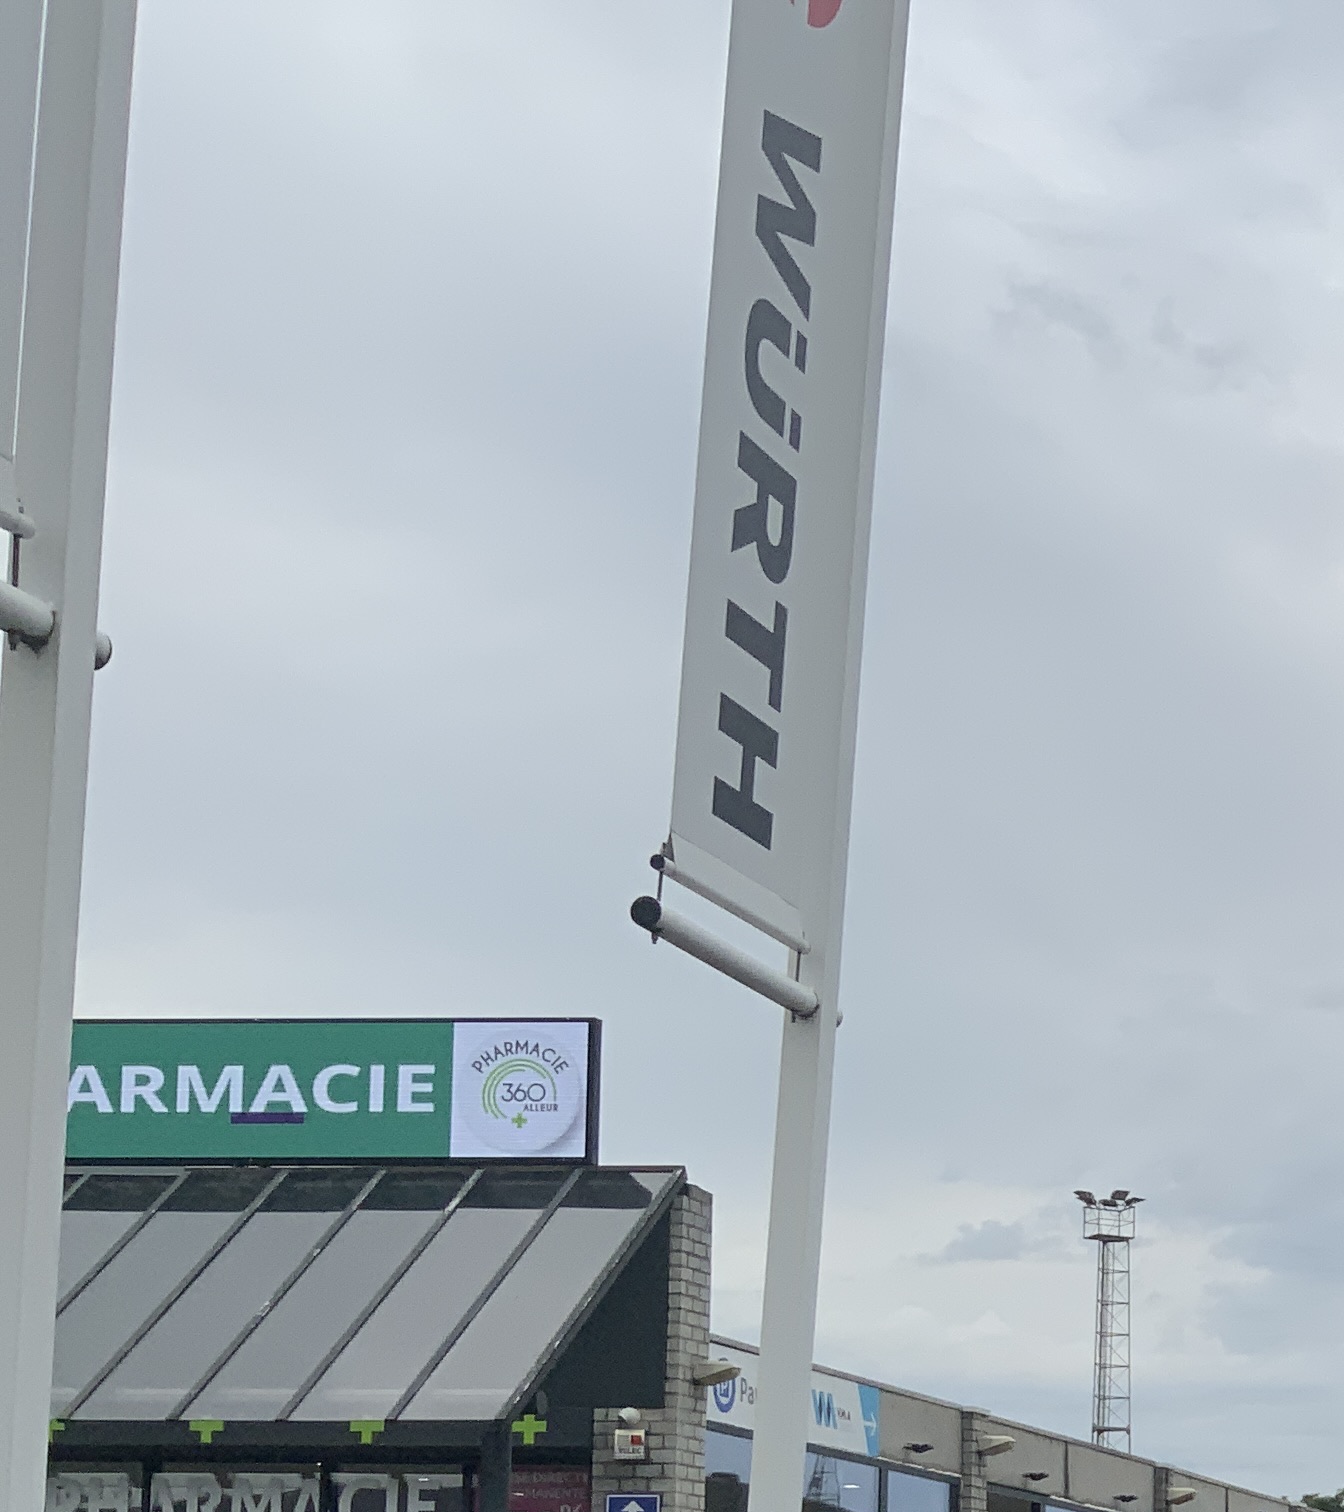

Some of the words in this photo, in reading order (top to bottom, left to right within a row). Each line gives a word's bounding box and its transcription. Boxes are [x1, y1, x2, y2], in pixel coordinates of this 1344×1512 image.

[711, 109, 823, 851] WÜRTH
[471, 1040, 569, 1075] PHARMACIE
[501, 1083, 546, 1102] 360
[523, 1104, 558, 1112] ALLEUR
